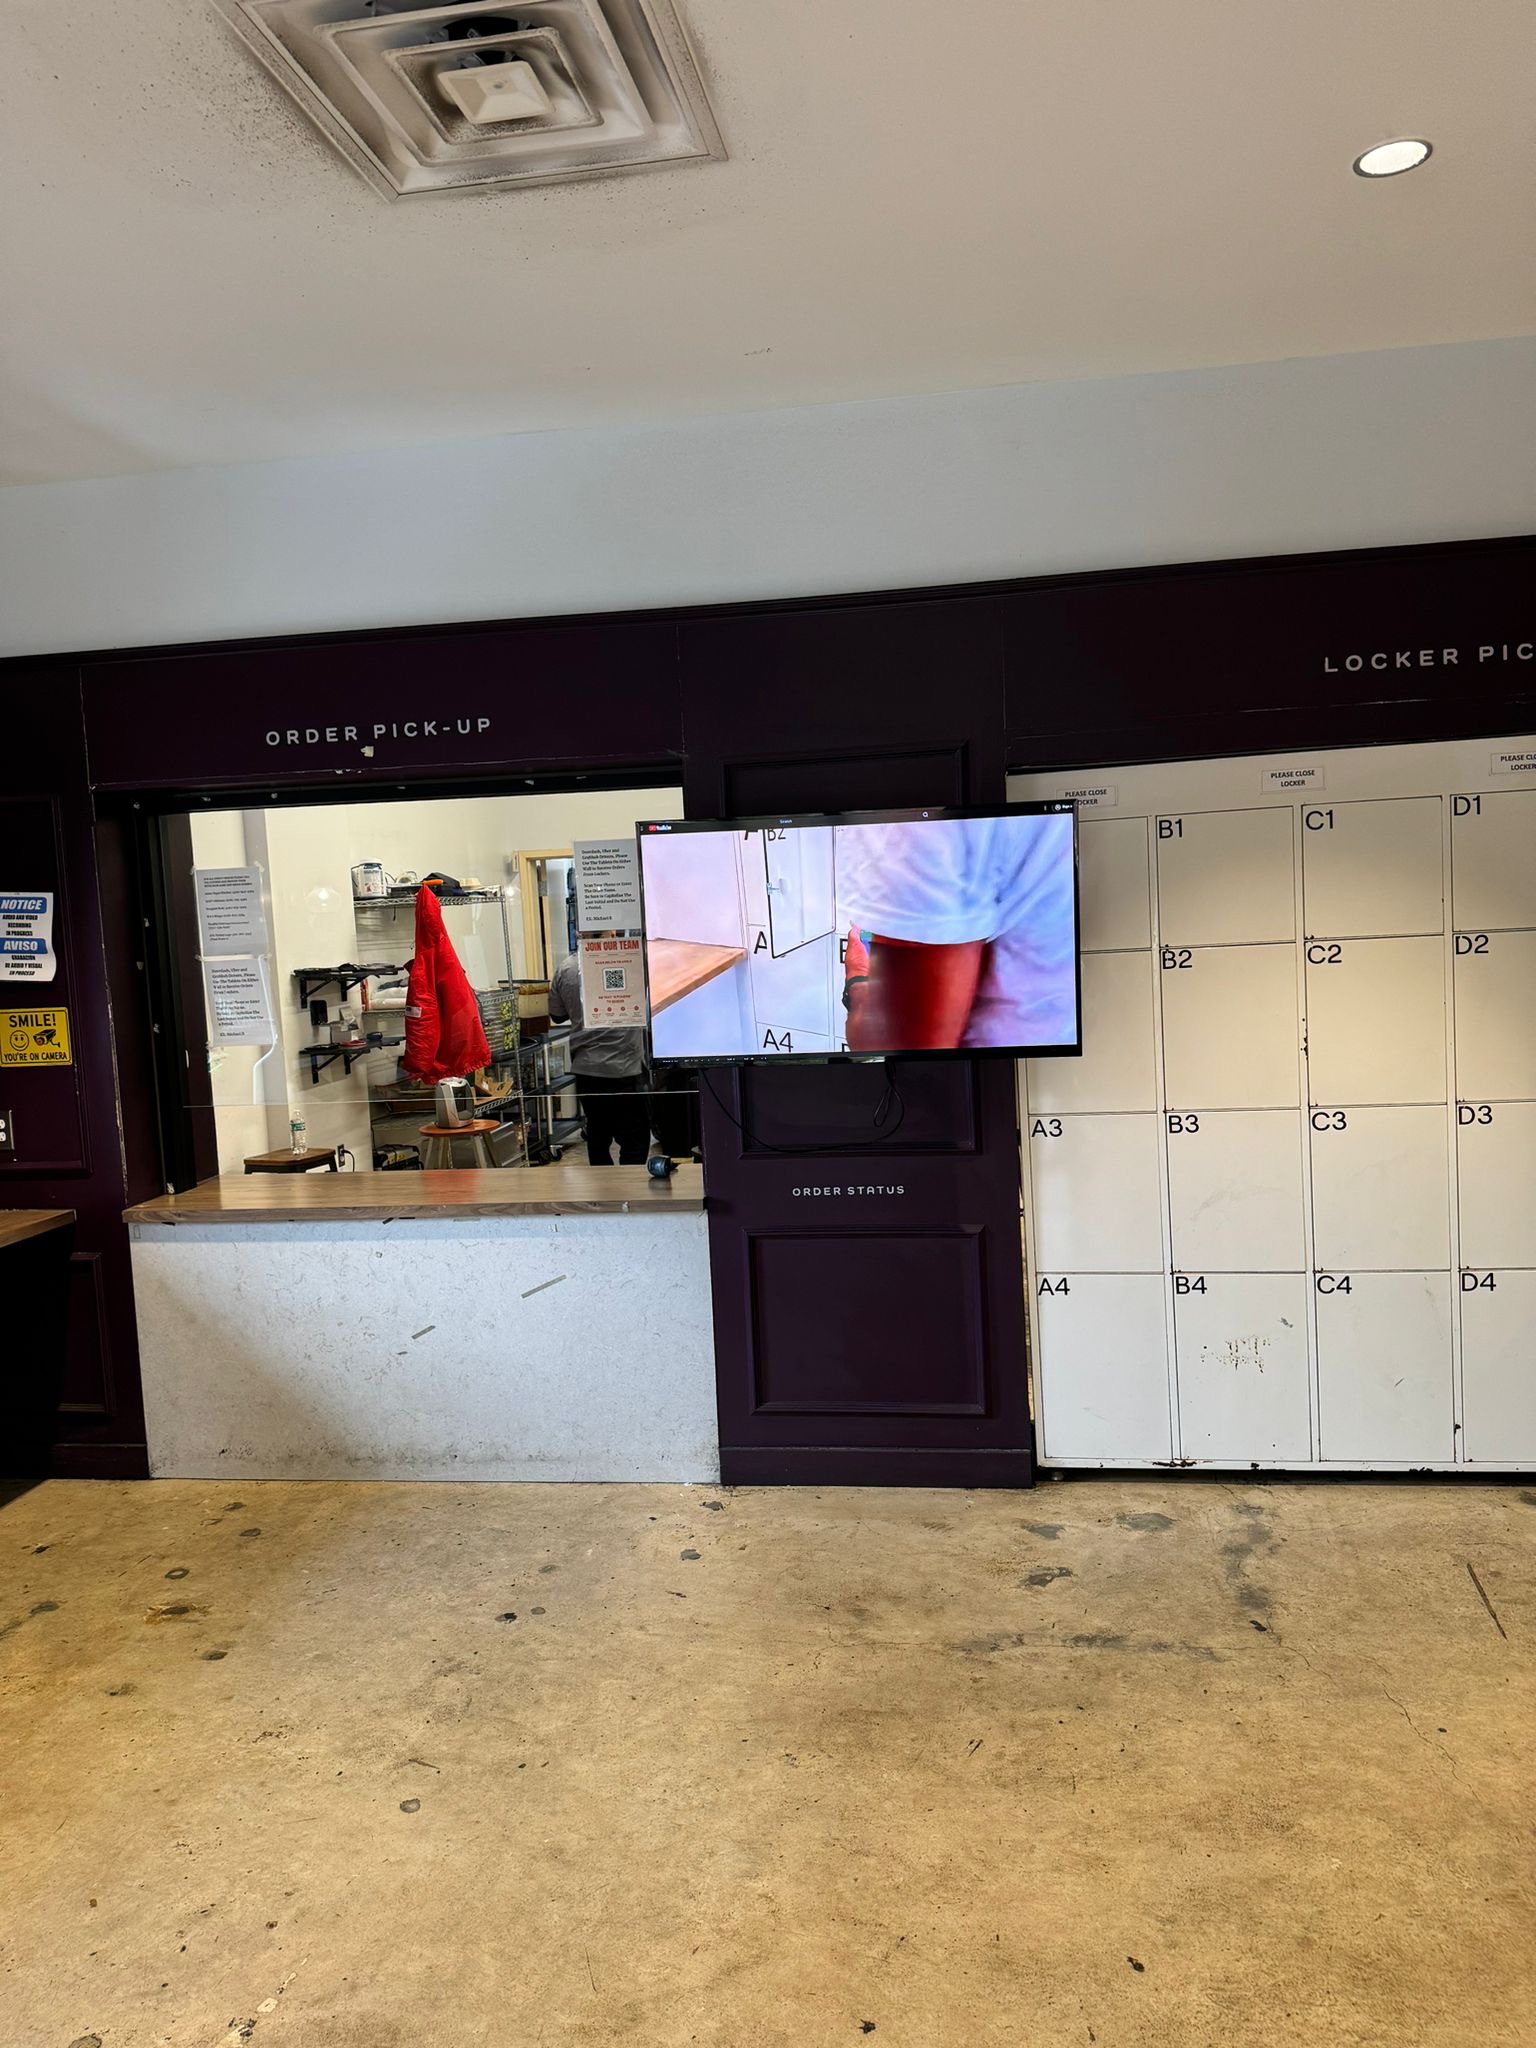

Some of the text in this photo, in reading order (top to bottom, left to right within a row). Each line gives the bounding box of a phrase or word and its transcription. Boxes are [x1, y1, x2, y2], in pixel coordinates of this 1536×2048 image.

[1324, 643, 1533, 672] LOCKER PIC
[266, 718, 490, 745] ORDER PICK-UP
[1500, 754, 1524, 762] PLEASE
[1511, 763, 1536, 771] LOCKER
[1270, 769, 1315, 779] PLEASE CLOSE
[1453, 795, 1481, 816] D1
[1158, 818, 1183, 839] B1
[1305, 809, 1334, 831] C1
[0, 899, 43, 911] NOTICE
[4, 940, 38, 951] AVISO
[585, 940, 640, 951] JOIN OUR TEAM
[754, 931, 768, 955] A
[1455, 934, 1489, 955] D2
[1162, 950, 1192, 970] B2
[1307, 944, 1342, 964] C2
[9, 1013, 56, 1028] SMILE!
[763, 1029, 793, 1053] A4
[4, 1052, 67, 1062] YOU'RE ON CAMERA
[1168, 1114, 1199, 1134] B3
[1311, 1111, 1347, 1131] C3
[1458, 1105, 1493, 1125] D3
[1031, 1119, 1063, 1137] A3
[792, 1185, 905, 1196] ORDER STATUS
[1038, 1278, 1070, 1296] A4
[1175, 1276, 1207, 1295] B4
[1316, 1275, 1352, 1294] C4
[1461, 1272, 1496, 1292] D4
